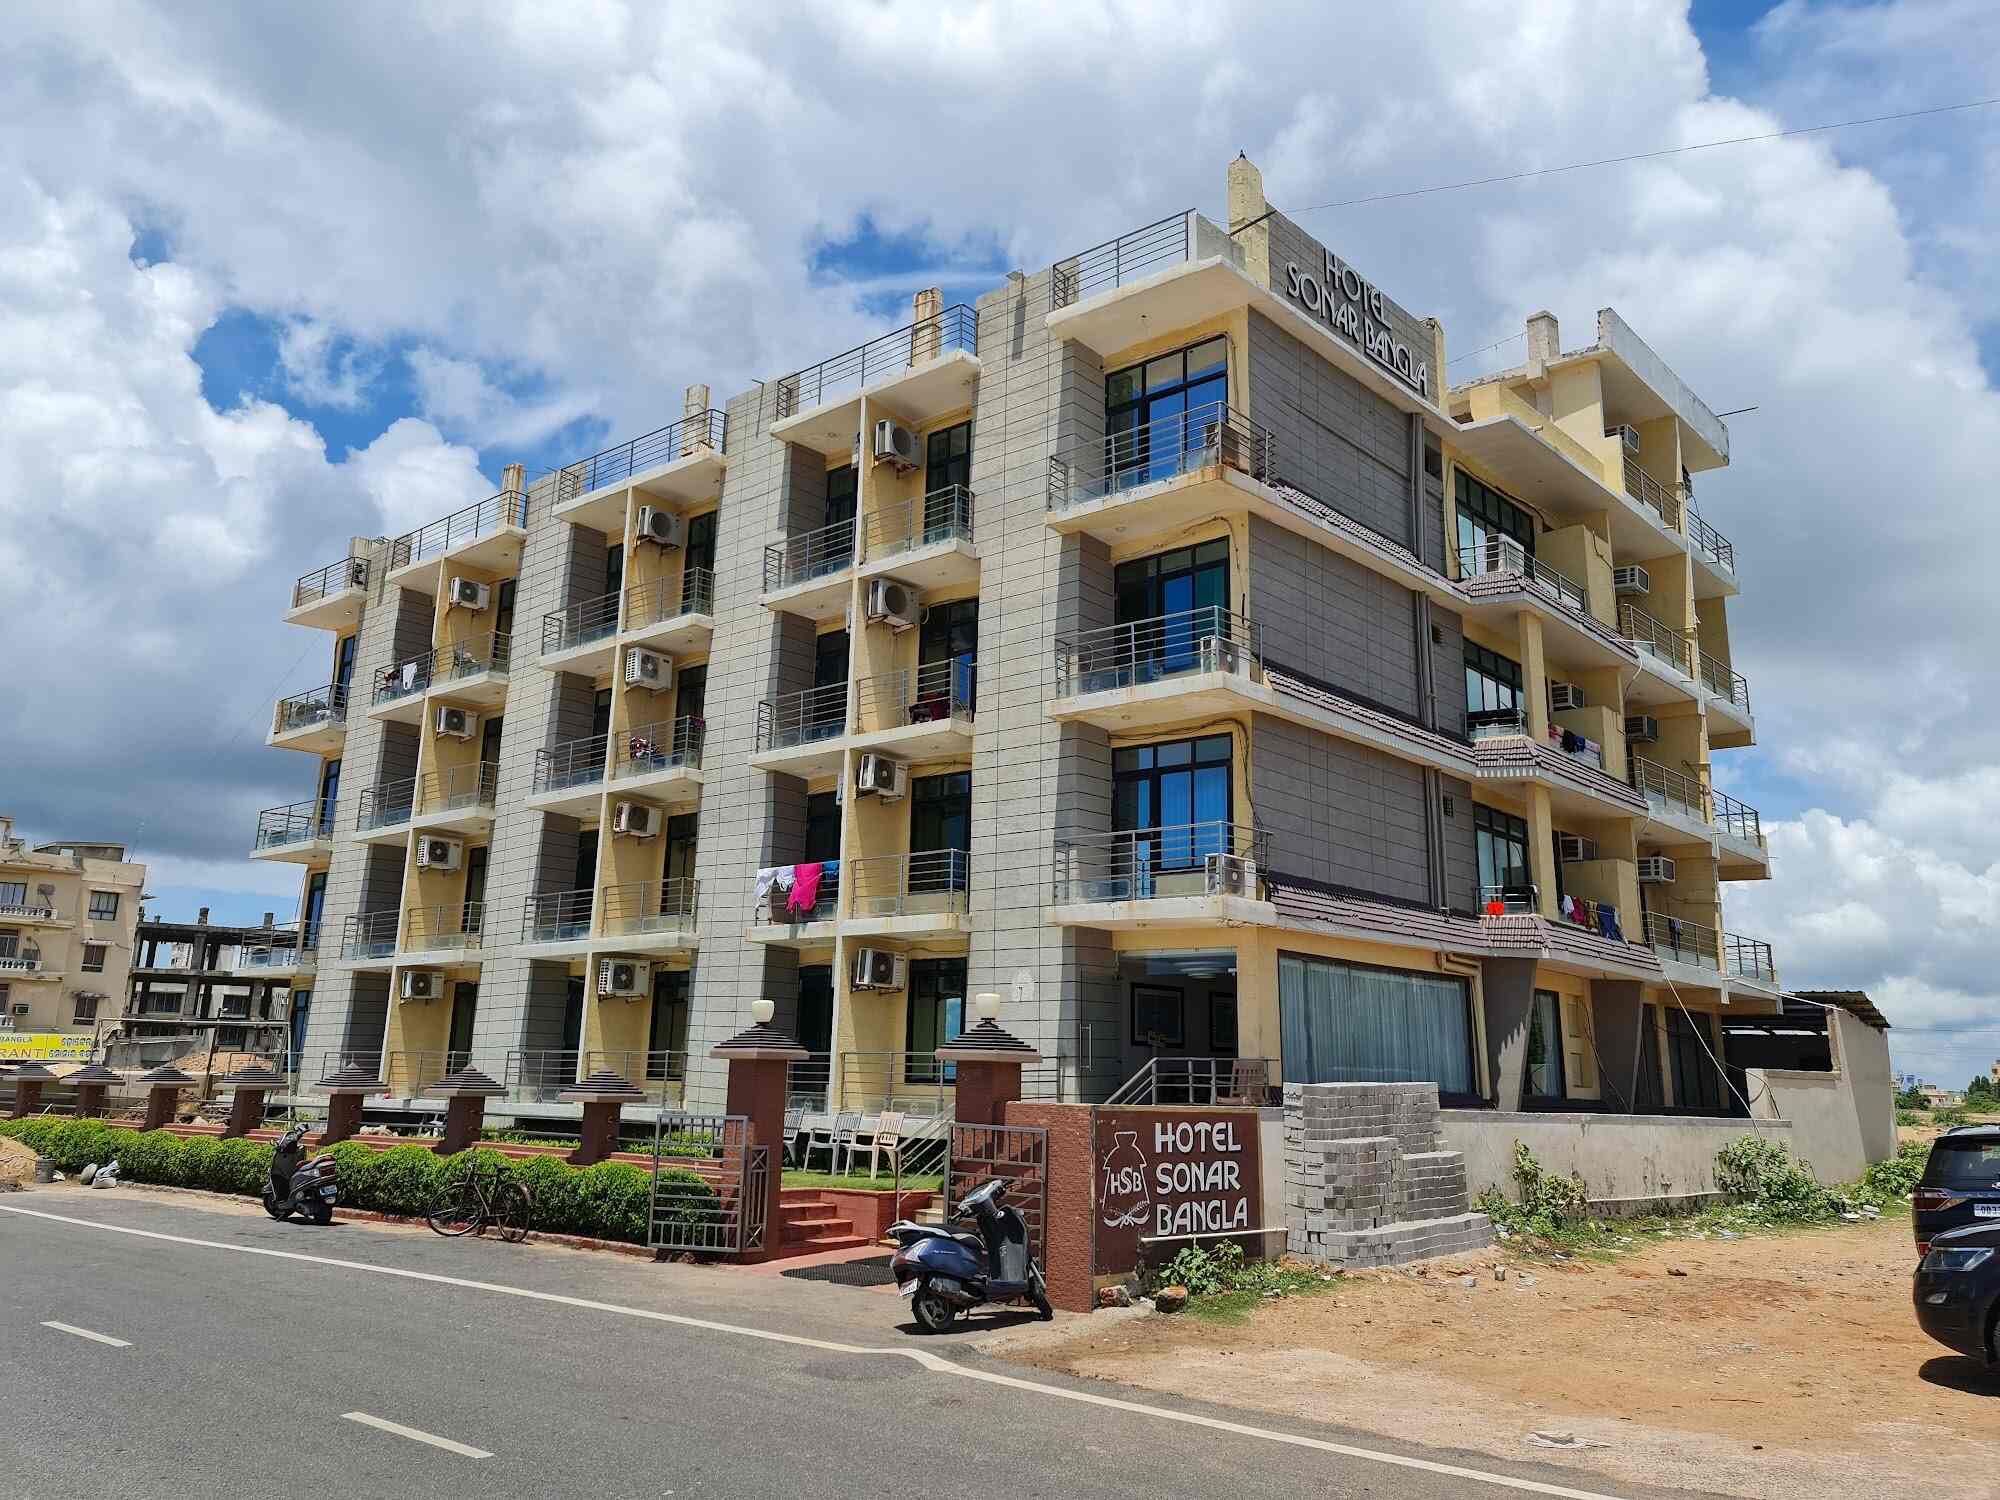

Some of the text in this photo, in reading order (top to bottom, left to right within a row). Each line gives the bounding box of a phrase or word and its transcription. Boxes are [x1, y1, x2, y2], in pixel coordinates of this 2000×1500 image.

[1322, 248, 1392, 331] HOTEL
[1285, 261, 1428, 396] SONAR BANGLA
[1155, 1121, 1242, 1153] HOTEL
[1110, 1166, 1143, 1196] HSB
[1155, 1160, 1241, 1195] SONAR
[1156, 1197, 1248, 1236] BANGLA
